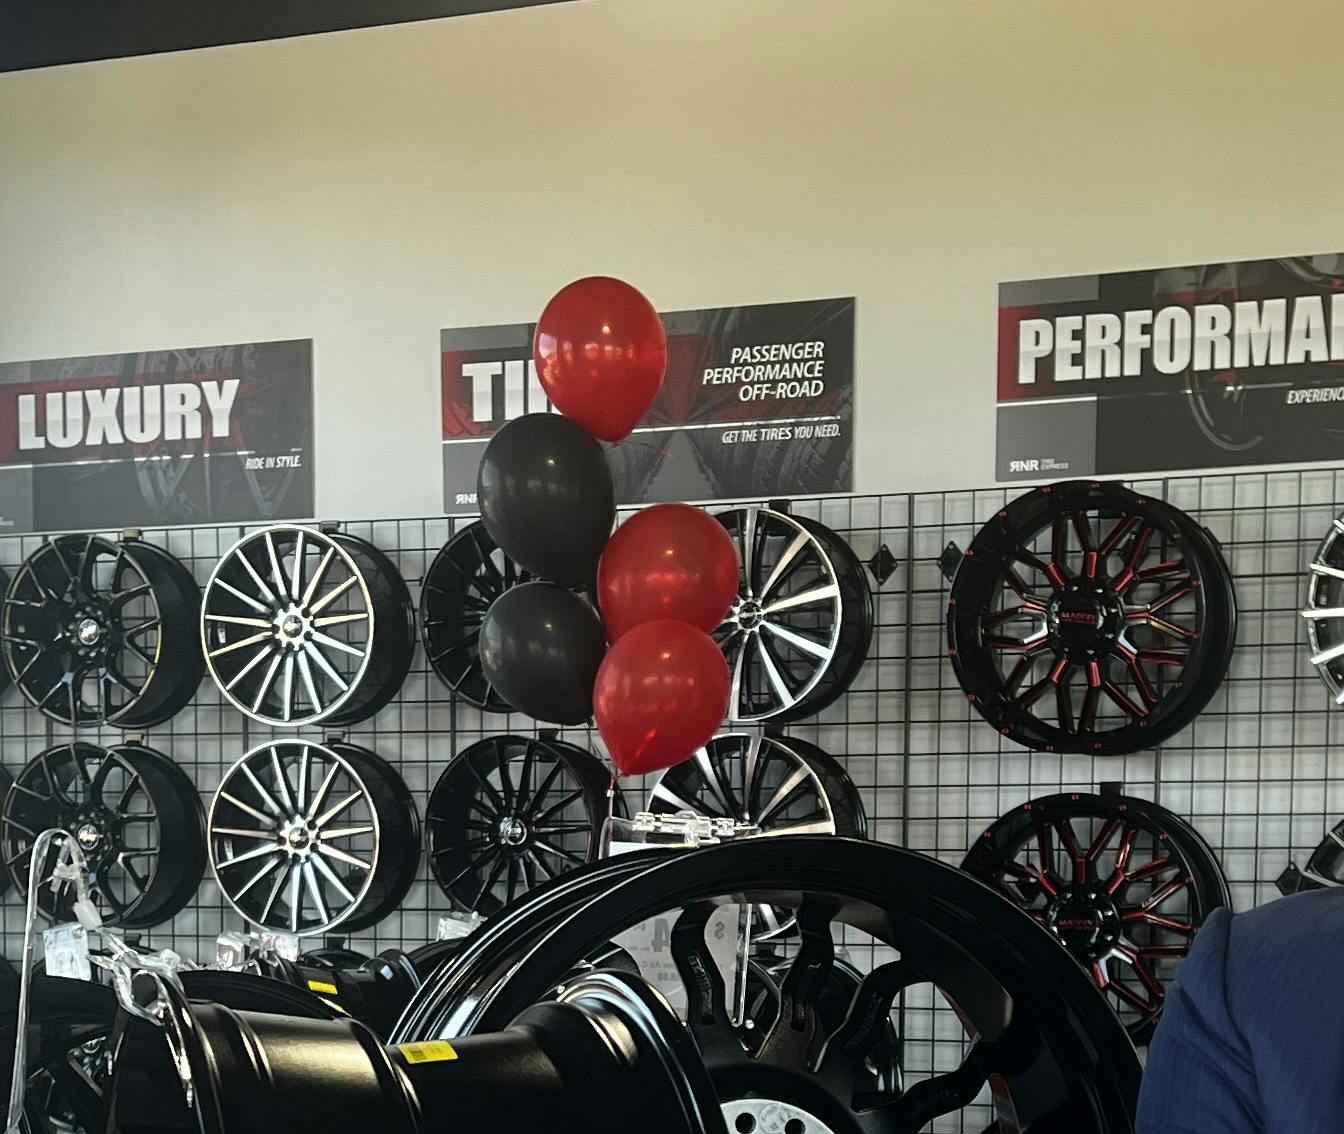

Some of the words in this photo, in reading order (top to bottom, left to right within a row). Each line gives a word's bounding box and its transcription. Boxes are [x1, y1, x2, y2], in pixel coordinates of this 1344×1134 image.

[730, 341, 825, 364] PASSENGER
[702, 361, 824, 386] PERFORMANCE
[738, 380, 824, 402] OFF-ROAD
[18, 378, 240, 451] LUXURY
[722, 431, 740, 444] GET
[741, 429, 758, 442] THE
[760, 427, 793, 441] TIRES
[794, 425, 814, 439] YOU
[245, 456, 265, 470] RIDE
[265, 456, 276, 469] IN
